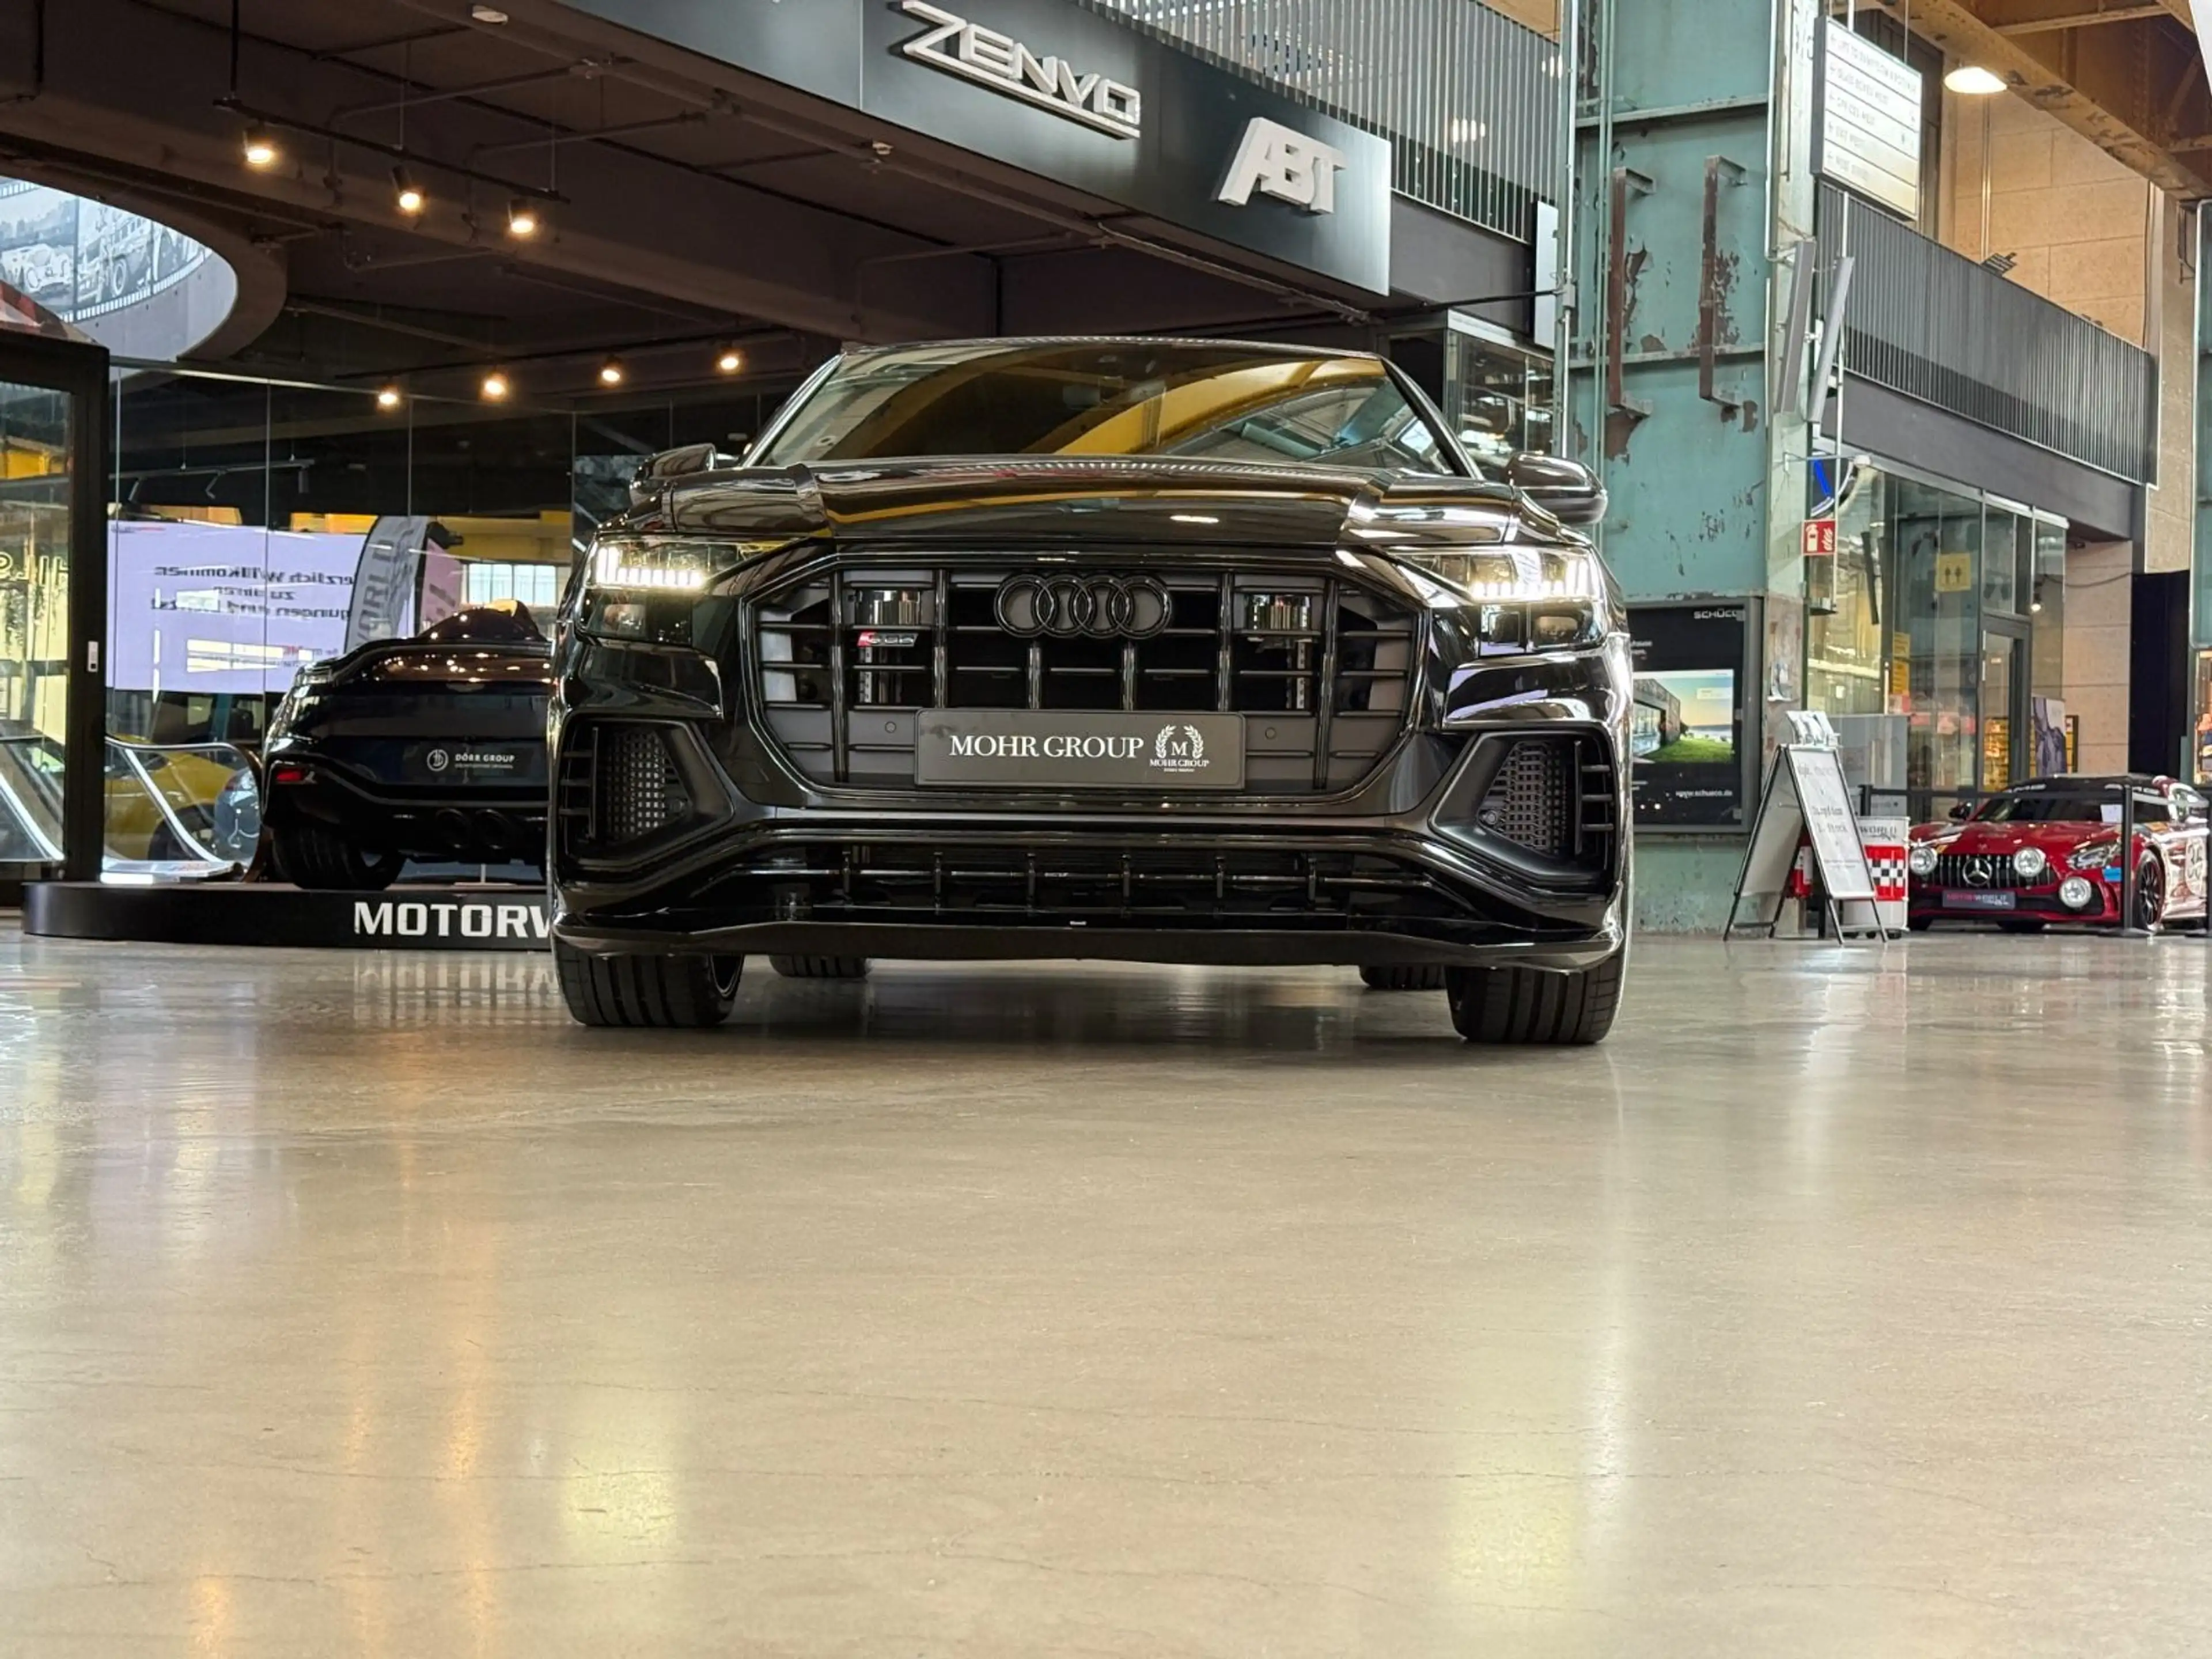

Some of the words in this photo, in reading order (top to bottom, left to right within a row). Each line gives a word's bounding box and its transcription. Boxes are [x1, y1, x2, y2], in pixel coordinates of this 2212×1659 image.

[901, 1, 1141, 139] ZENVO
[1219, 117, 1347, 214] ABT
[949, 734, 1039, 757] MOHR
[1043, 736, 1144, 759] GROUP
[1171, 741, 1188, 756] M
[483, 754, 515, 763] GROUP
[1149, 758, 1177, 767] MOHR
[1177, 759, 1209, 768] GROUP
